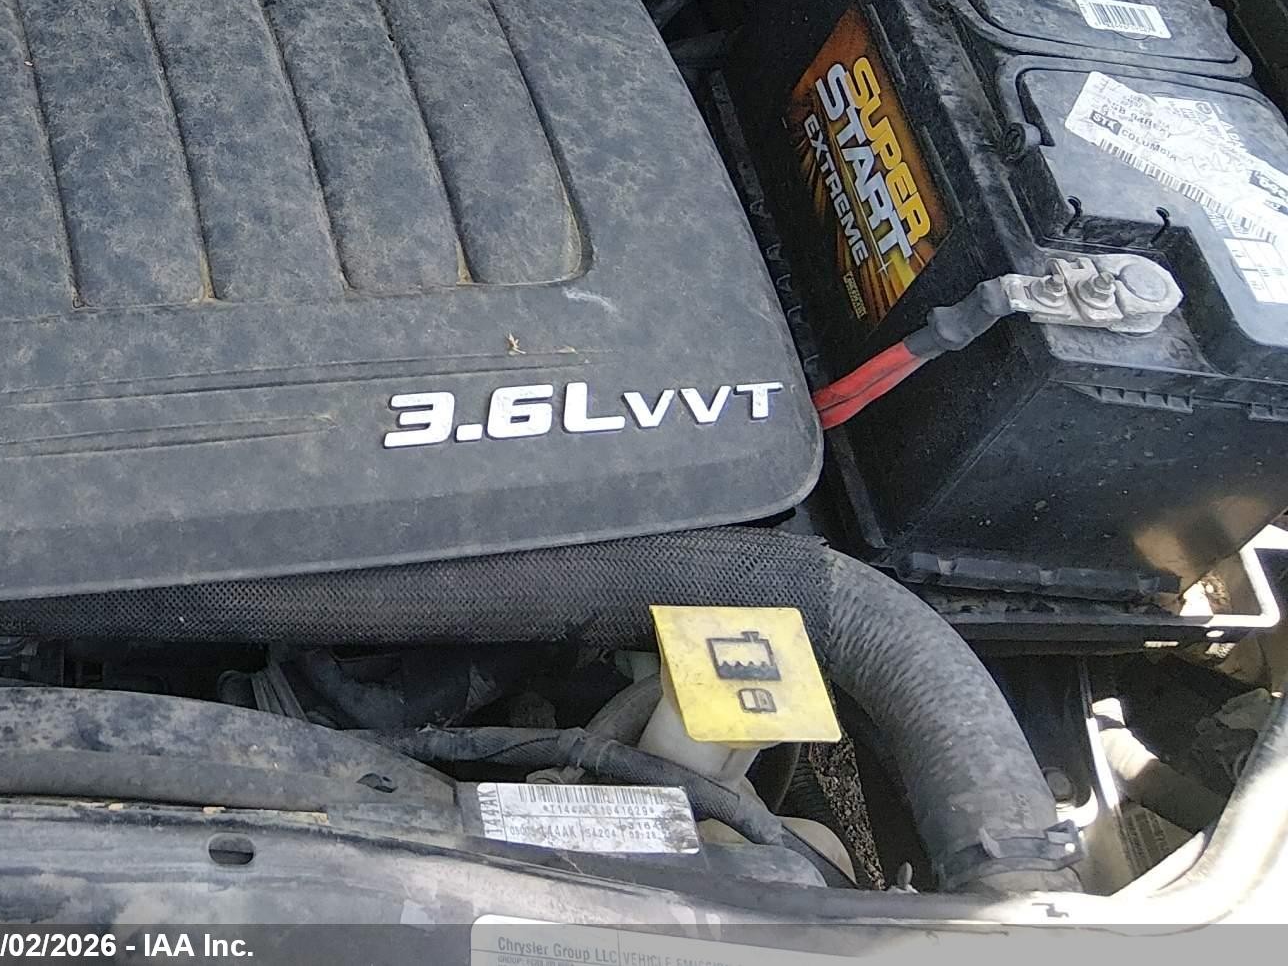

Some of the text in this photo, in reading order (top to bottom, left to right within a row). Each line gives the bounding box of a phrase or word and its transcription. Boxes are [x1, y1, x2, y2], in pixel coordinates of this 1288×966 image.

[803, 116, 870, 267] EXTREME
[815, 62, 913, 261] START
[846, 56, 932, 248] SUPER
[478, 789, 504, 836] 144AK
[497, 935, 549, 956] Chrysler
[552, 942, 591, 963] Group
[594, 946, 619, 963] LLC
